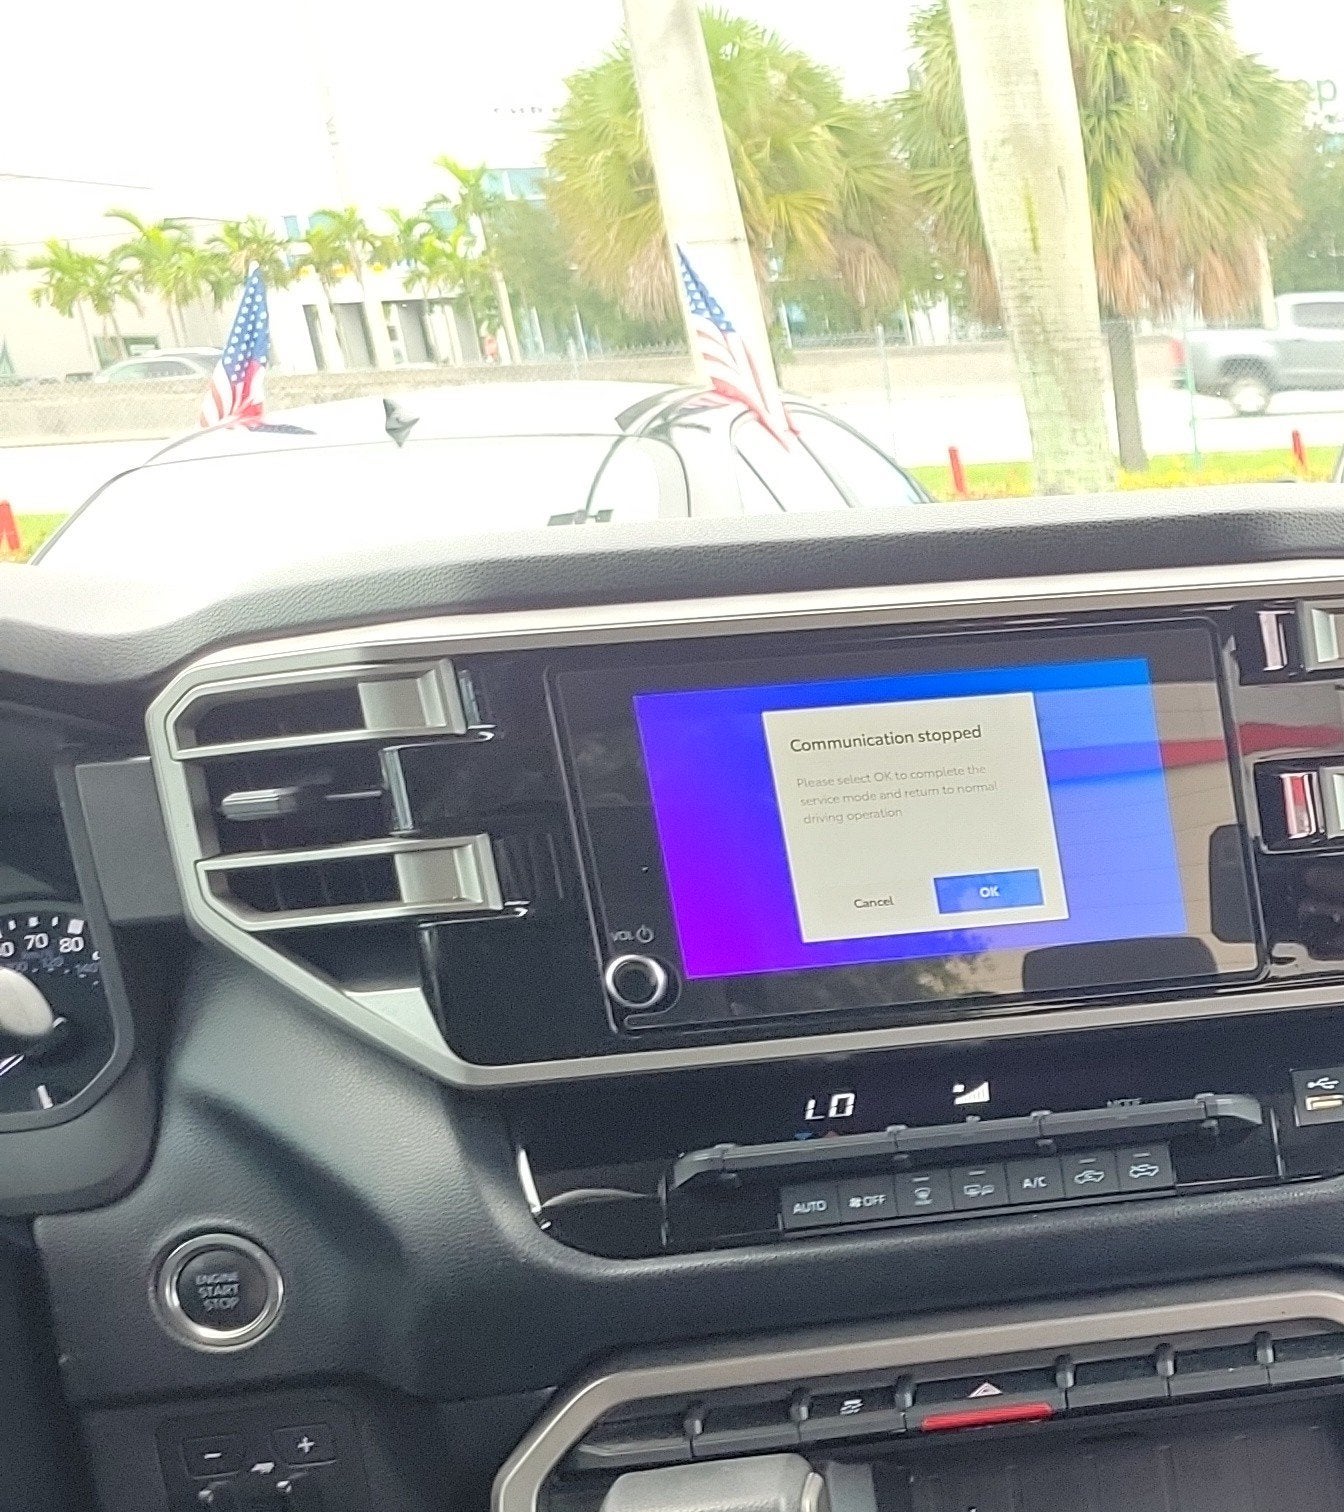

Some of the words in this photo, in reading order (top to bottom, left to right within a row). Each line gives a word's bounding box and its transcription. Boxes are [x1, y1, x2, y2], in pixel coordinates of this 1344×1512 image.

[790, 732, 914, 752] Communication
[918, 725, 982, 744] stopped
[797, 777, 835, 788] Please
[837, 774, 871, 785] select
[873, 772, 892, 782] OK
[895, 770, 908, 780] to
[910, 766, 965, 781] complete
[967, 764, 986, 774] the
[800, 795, 839, 806] service
[842, 791, 877, 803] mode
[879, 789, 901, 800] and
[905, 787, 940, 799] return
[942, 785, 954, 795] to
[957, 782, 998, 794] normal
[803, 812, 843, 824] driving
[847, 808, 903, 822] operation
[979, 886, 1000, 898] OK
[853, 896, 895, 908] Cancel
[0, 941, 15, 957] 0
[24, 933, 49, 950] 70
[60, 937, 84, 953] 80
[804, 1092, 856, 1121] LO
[1022, 1176, 1047, 1190] A/C
[793, 1201, 827, 1214] AUTO
[861, 1194, 887, 1208] OFF
[199, 1283, 239, 1298] START
[203, 1297, 239, 1311] STOP
